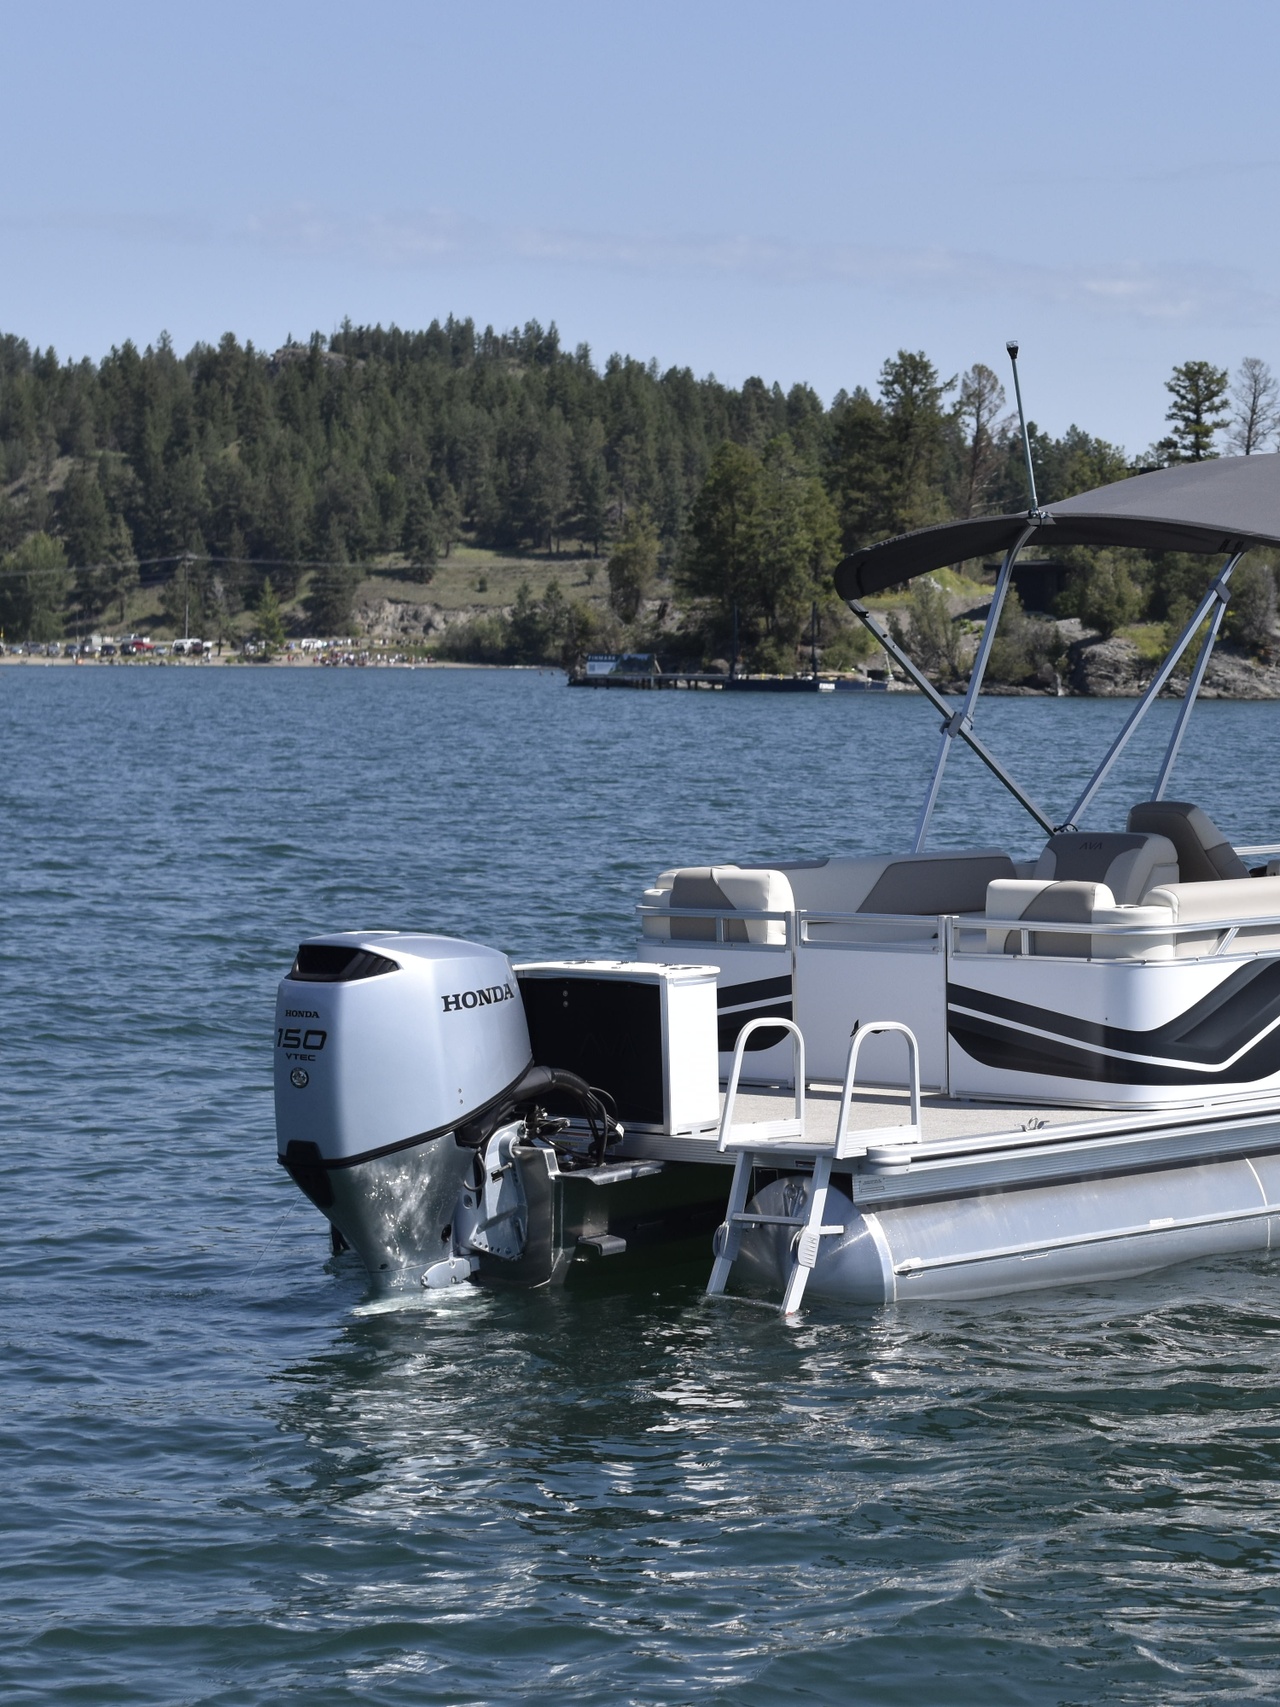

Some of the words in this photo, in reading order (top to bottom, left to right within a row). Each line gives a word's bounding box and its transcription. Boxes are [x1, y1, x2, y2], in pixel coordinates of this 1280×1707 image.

[1079, 842, 1103, 850] AVA
[441, 983, 514, 1012] HONDA
[285, 1009, 320, 1019] HONDA
[277, 1028, 327, 1050] 150
[285, 1052, 316, 1062] VTEC
